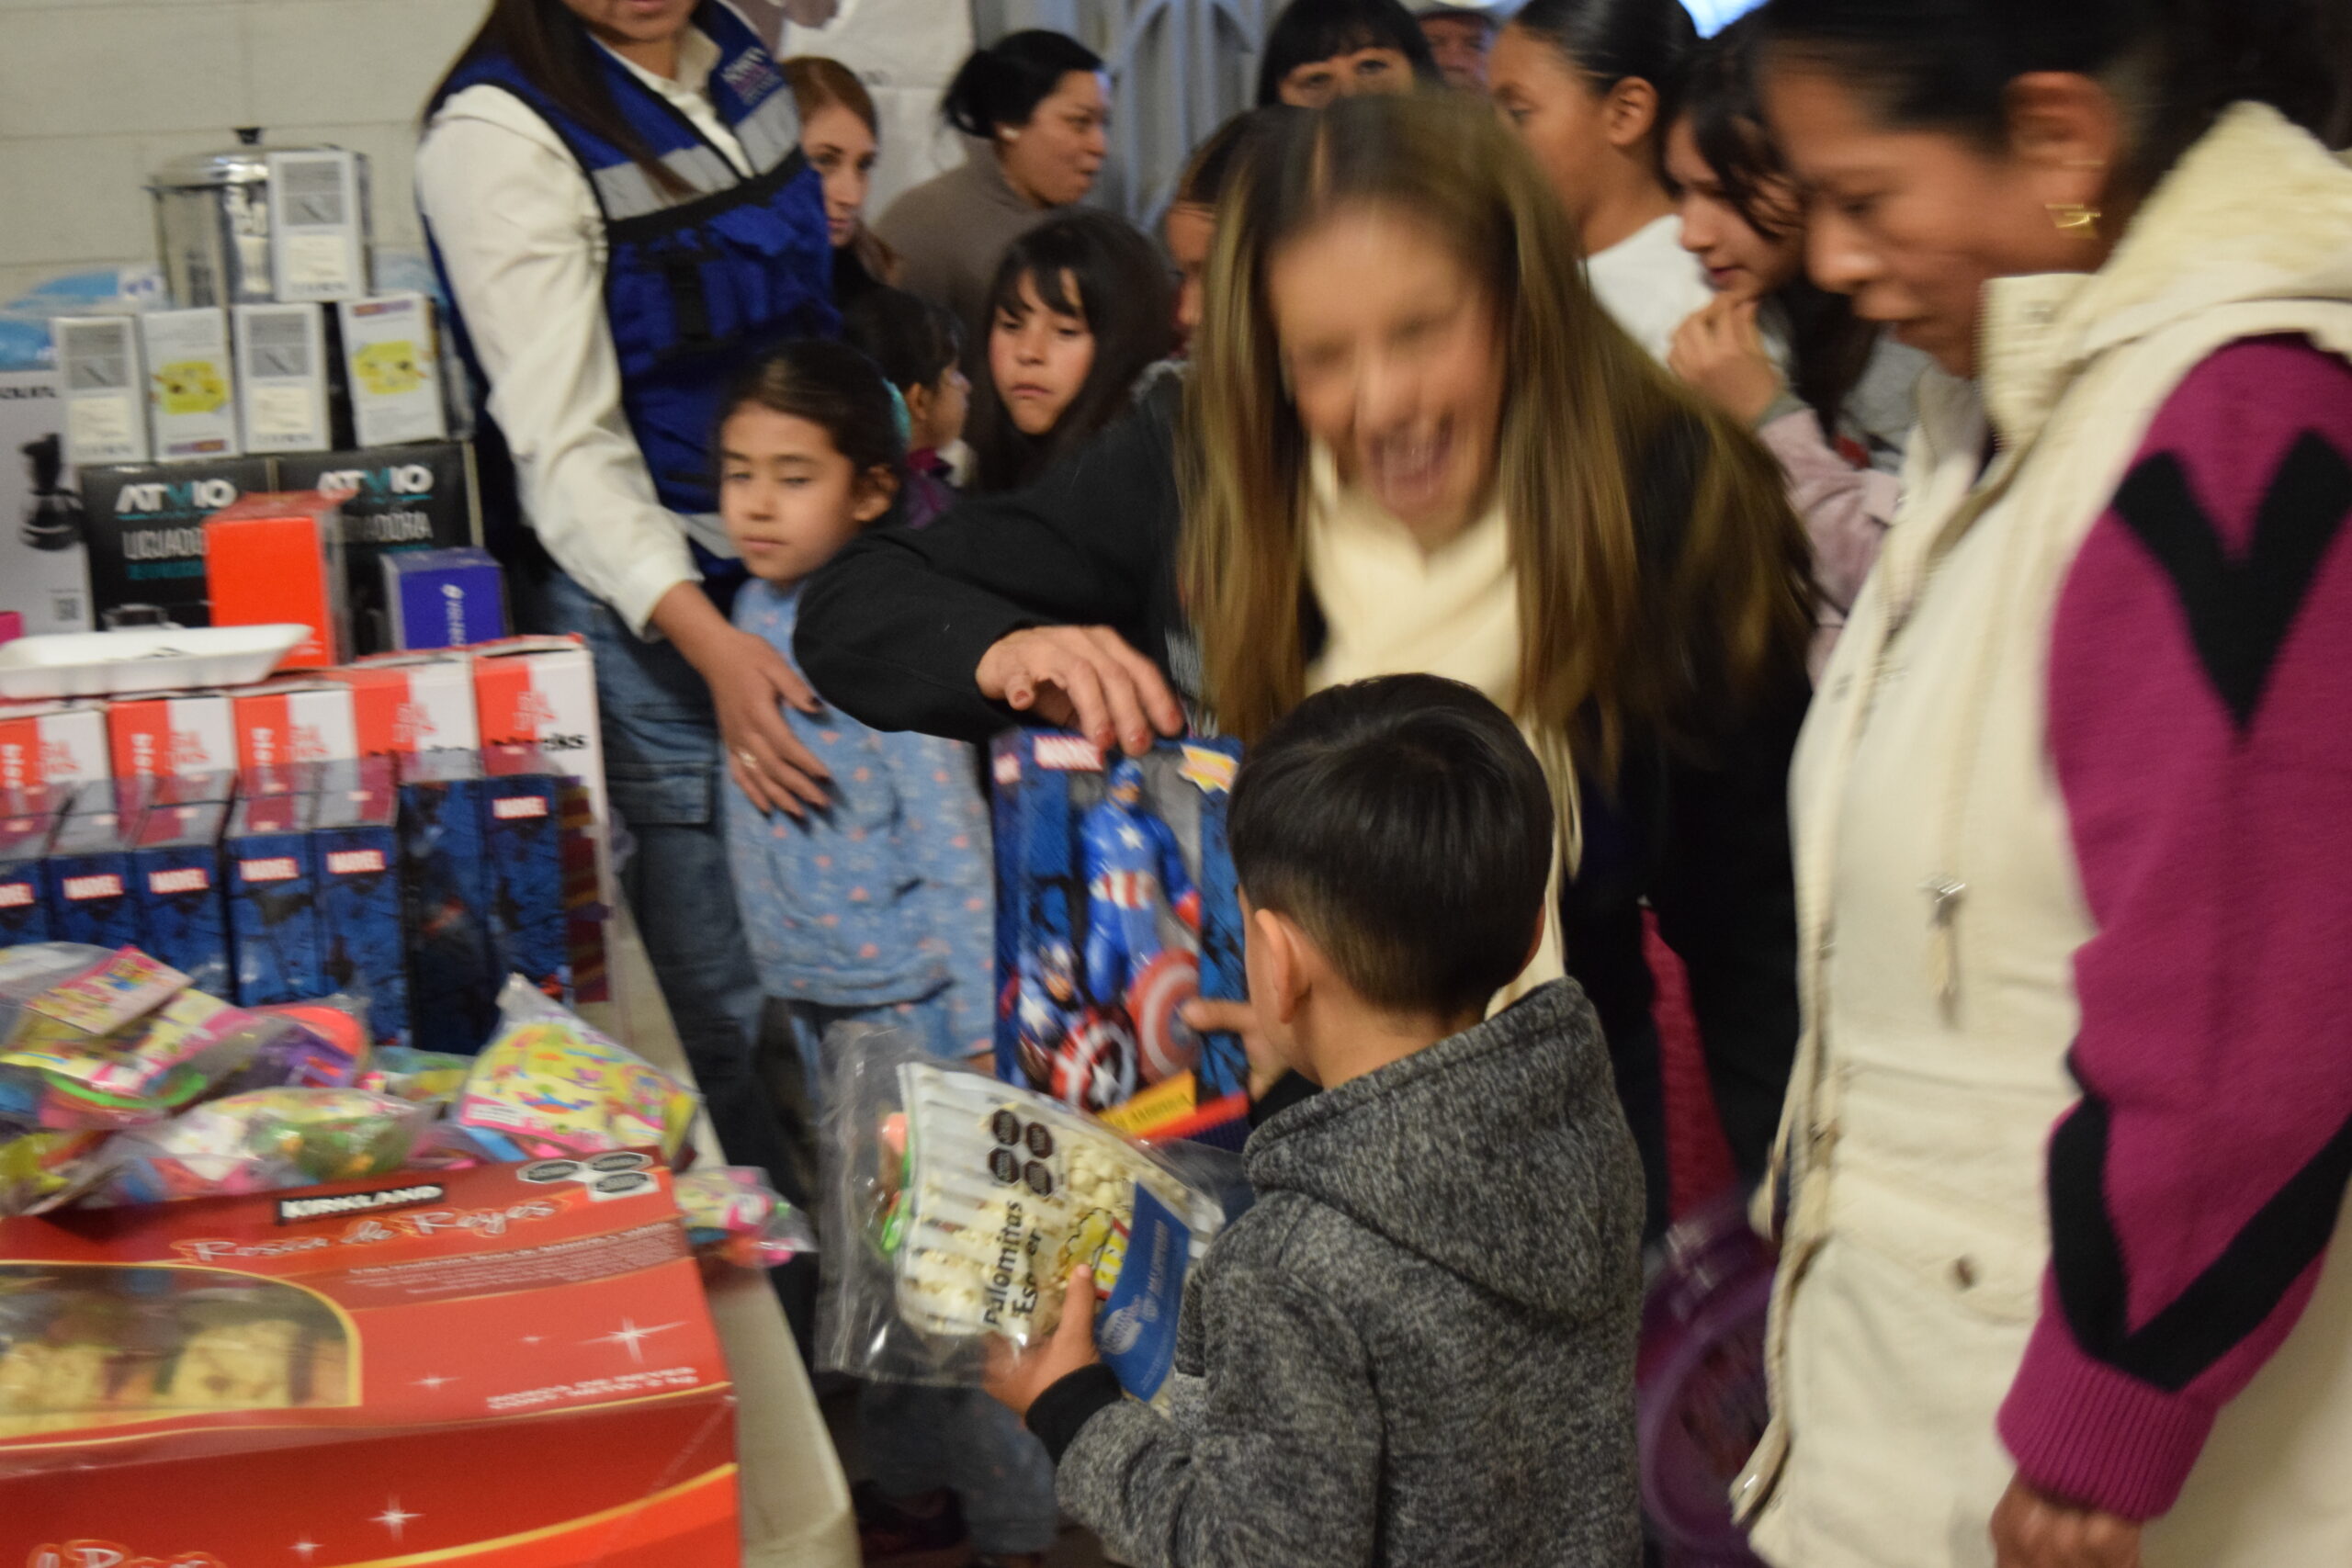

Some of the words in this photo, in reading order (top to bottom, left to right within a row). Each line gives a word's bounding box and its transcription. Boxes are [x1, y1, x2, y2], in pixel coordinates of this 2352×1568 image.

[115, 479, 237, 513] ATVIO
[317, 464, 435, 499] ATVIO
[241, 858, 299, 881] MARVEL
[327, 851, 385, 874] MARVEL
[63, 874, 123, 899] MARVEL
[149, 869, 209, 894] MARVEL
[281, 1185, 443, 1218] KIRKLAND
[341, 1220, 393, 1245] de
[409, 1201, 556, 1235] Reyes
[983, 1200, 1023, 1325] Palomitas
